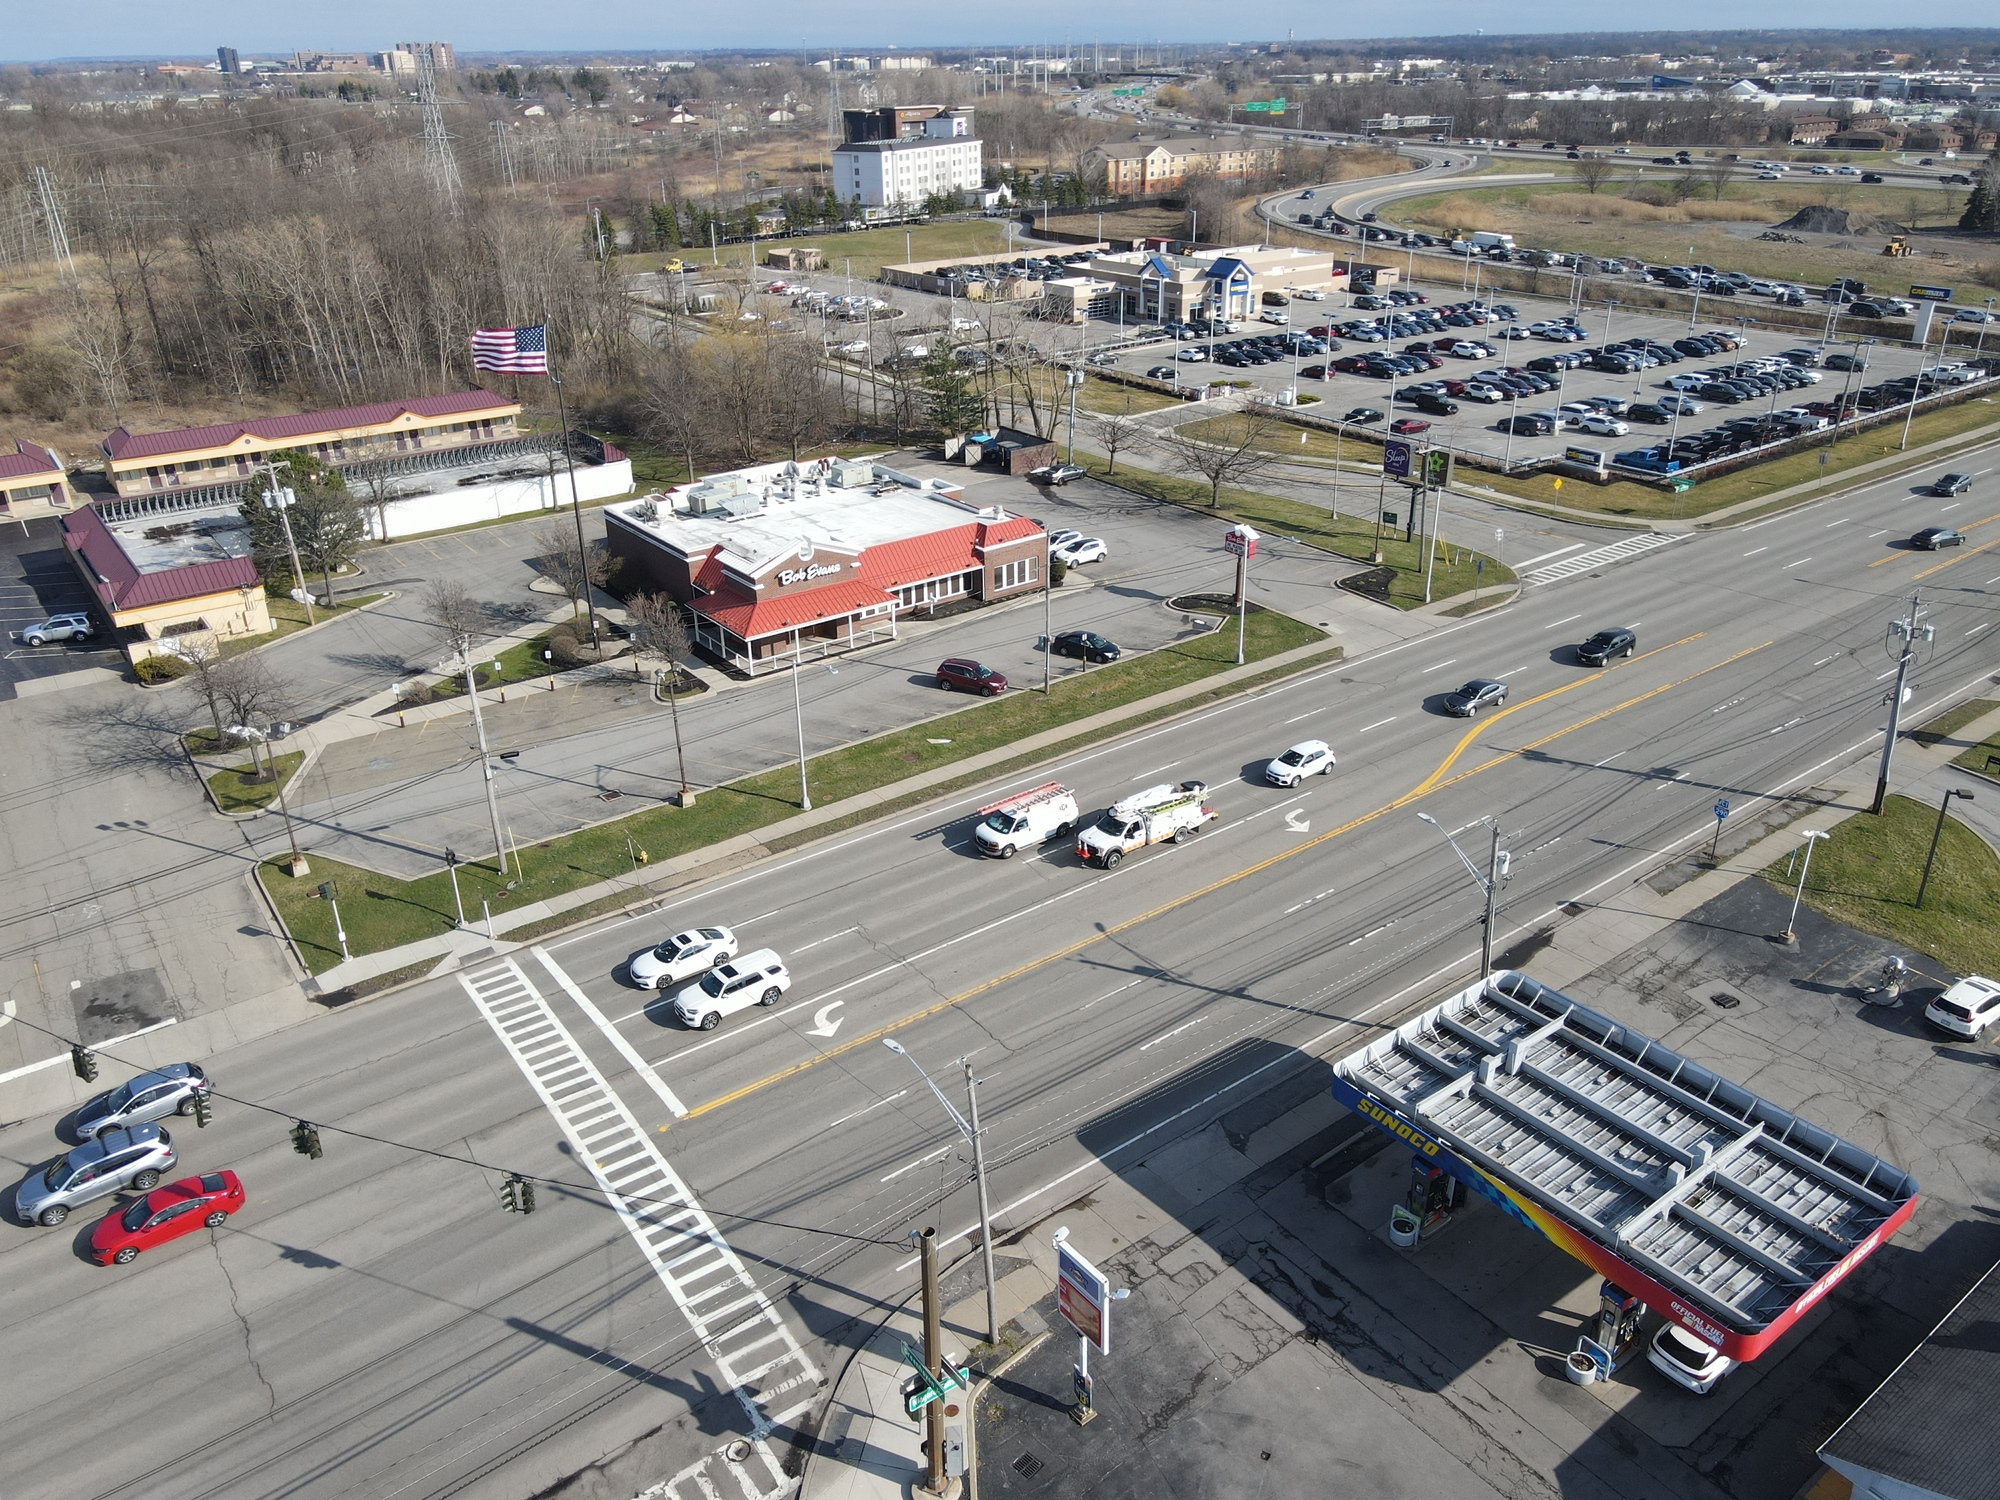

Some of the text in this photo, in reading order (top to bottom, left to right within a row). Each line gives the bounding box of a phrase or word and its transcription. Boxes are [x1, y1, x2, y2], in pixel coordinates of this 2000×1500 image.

[1385, 449, 1406, 465] Sleep
[778, 563, 840, 585] Bob Evans
[1715, 809, 1728, 817] 290
[1356, 1098, 1440, 1157] SUNOCO
[1670, 1301, 1725, 1340] OFFICIAL FUEL
[1692, 1322, 1724, 1347] NASCAR
